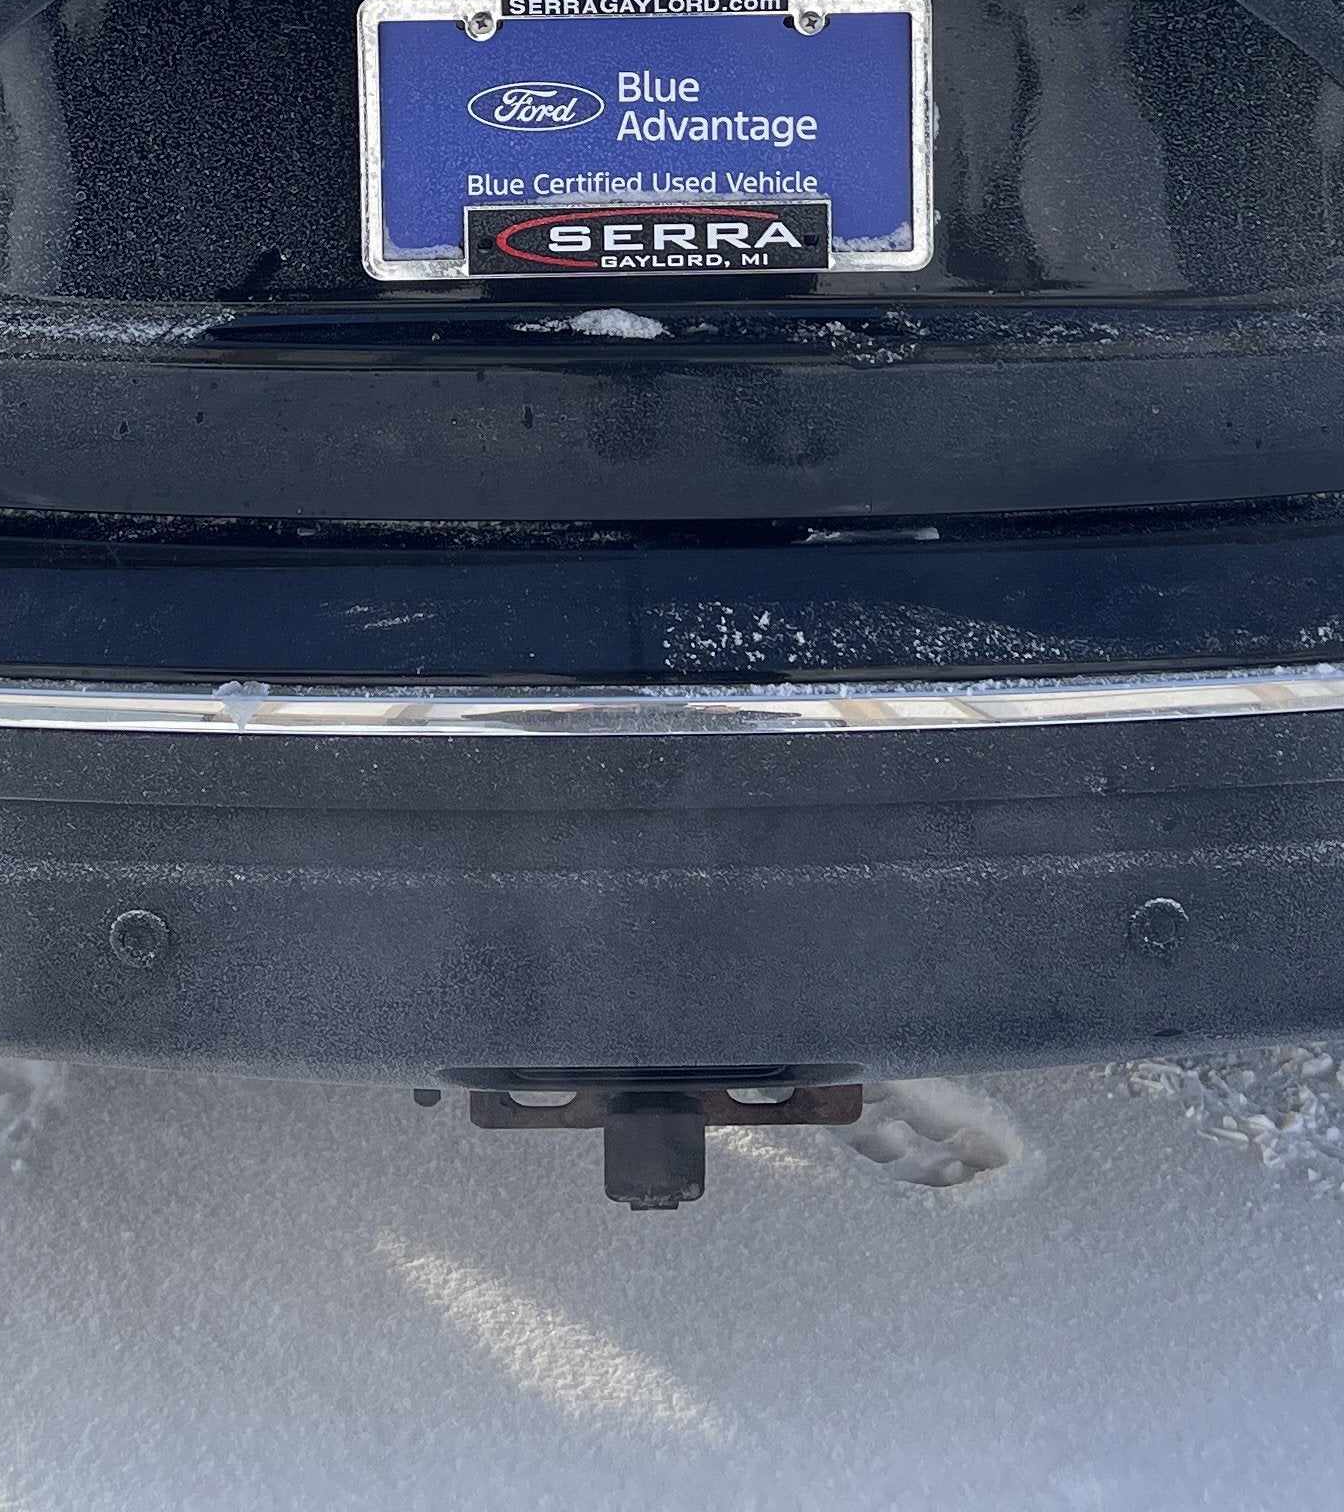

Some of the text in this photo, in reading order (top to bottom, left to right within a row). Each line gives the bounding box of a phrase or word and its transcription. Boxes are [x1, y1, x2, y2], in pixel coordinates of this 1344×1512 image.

[617, 70, 700, 103] Blue
[493, 88, 579, 124] Ford
[616, 109, 818, 148] Advantage
[467, 170, 819, 196] Blue Certified Used Vehicle
[548, 221, 803, 253] SERRA
[600, 252, 769, 269] GAYLORD, MI
